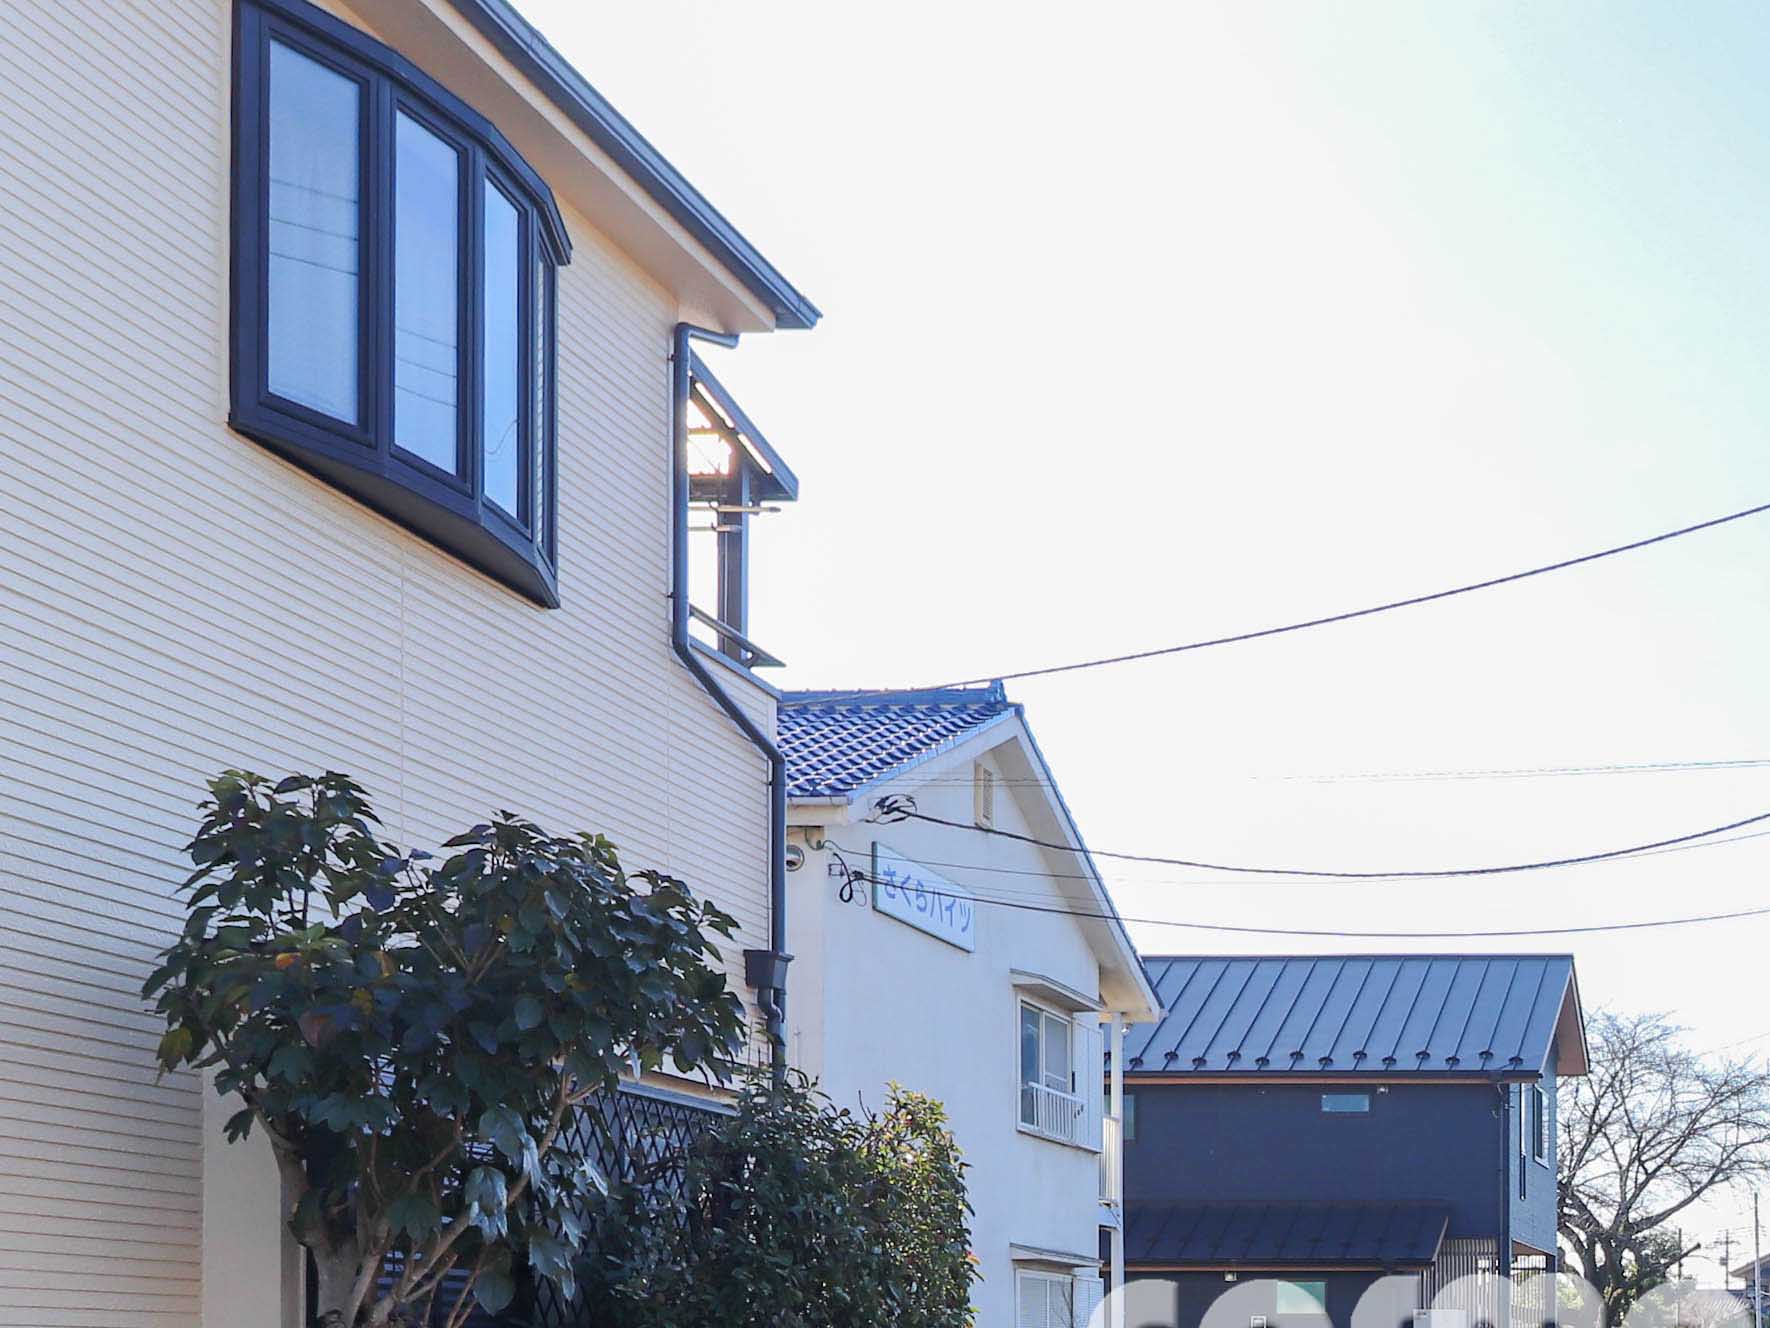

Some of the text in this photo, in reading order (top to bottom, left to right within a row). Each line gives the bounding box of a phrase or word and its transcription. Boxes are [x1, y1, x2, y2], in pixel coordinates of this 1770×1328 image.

[883, 865, 971, 933] さくらハイツ
